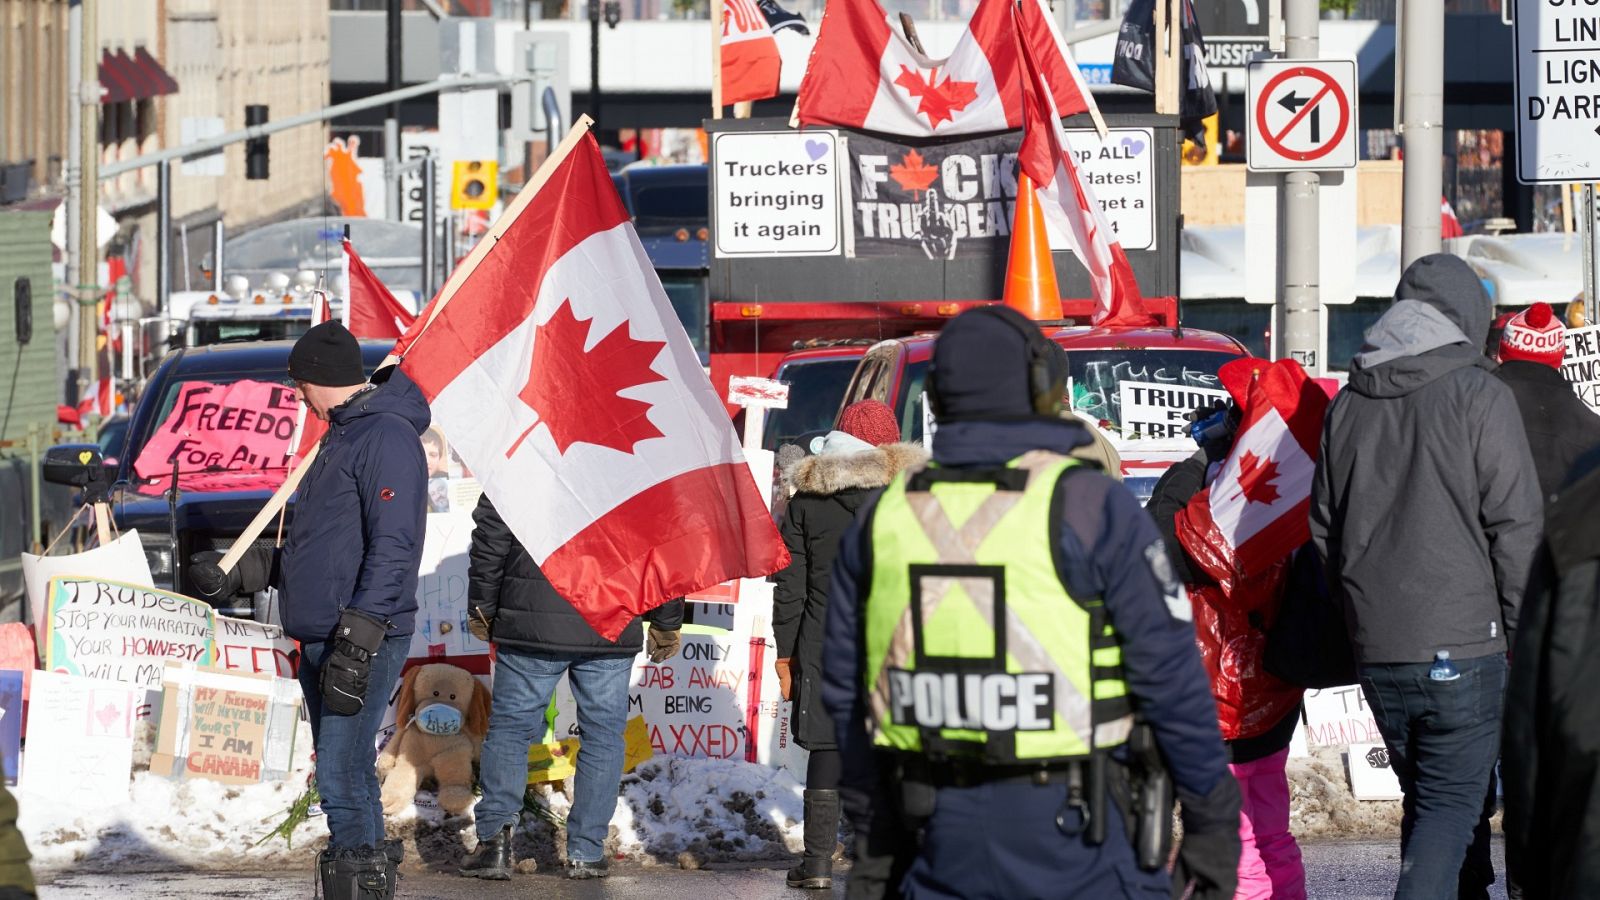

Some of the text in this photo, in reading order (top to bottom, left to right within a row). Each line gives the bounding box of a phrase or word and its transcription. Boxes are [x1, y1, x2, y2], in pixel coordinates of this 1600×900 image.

[1099, 146, 1135, 159] ALL
[724, 160, 828, 177] Truckers
[730, 191, 824, 210] bringing
[1134, 199, 1144, 209] a
[734, 221, 821, 241] it again
[54, 609, 214, 638] STOP YOUR NARRATIVE
[70, 634, 205, 661] YOUR HONNESTY
[683, 642, 731, 662] ONLY
[135, 664, 164, 685] MA
[637, 665, 745, 692] JAB AWAY
[195, 687, 217, 701] MY
[889, 671, 1052, 731] POLICE
[665, 695, 712, 714] BEING
[779, 717, 789, 749] FATHER
[198, 734, 253, 755] I AM
[186, 751, 260, 780] CANADA
